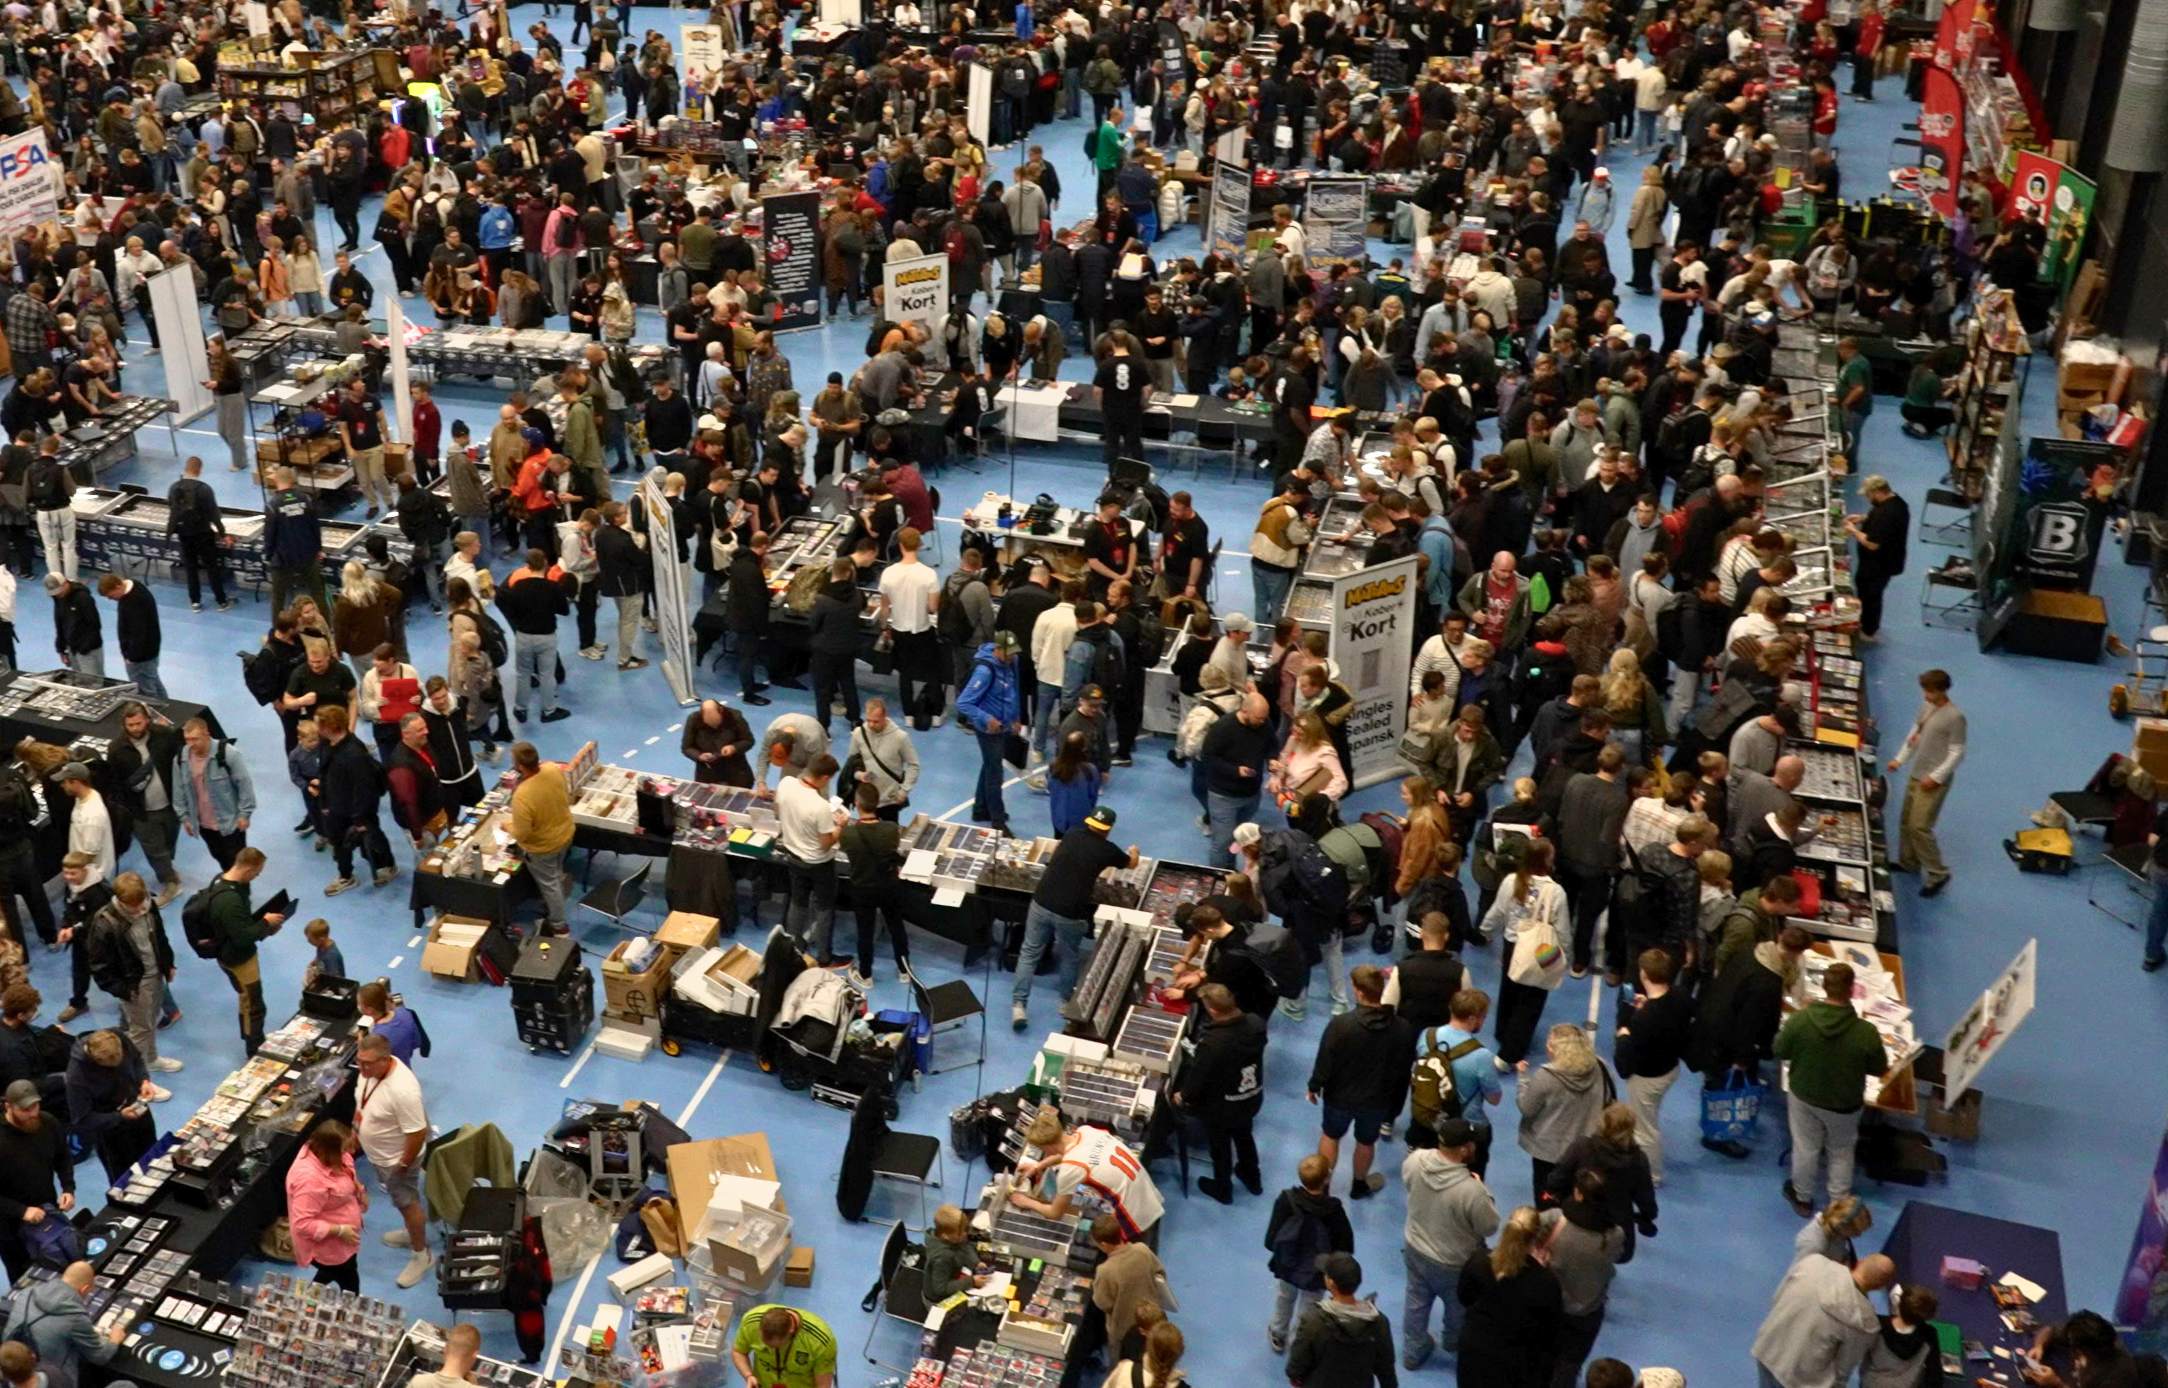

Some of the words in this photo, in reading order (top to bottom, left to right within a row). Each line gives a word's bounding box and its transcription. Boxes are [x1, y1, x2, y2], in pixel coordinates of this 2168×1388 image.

[1, 143, 47, 180] PSA
[901, 293, 936, 311] Kort
[2038, 513, 2078, 551] B
[1350, 614, 1396, 641] Kort
[1109, 1145, 1141, 1182] 11
